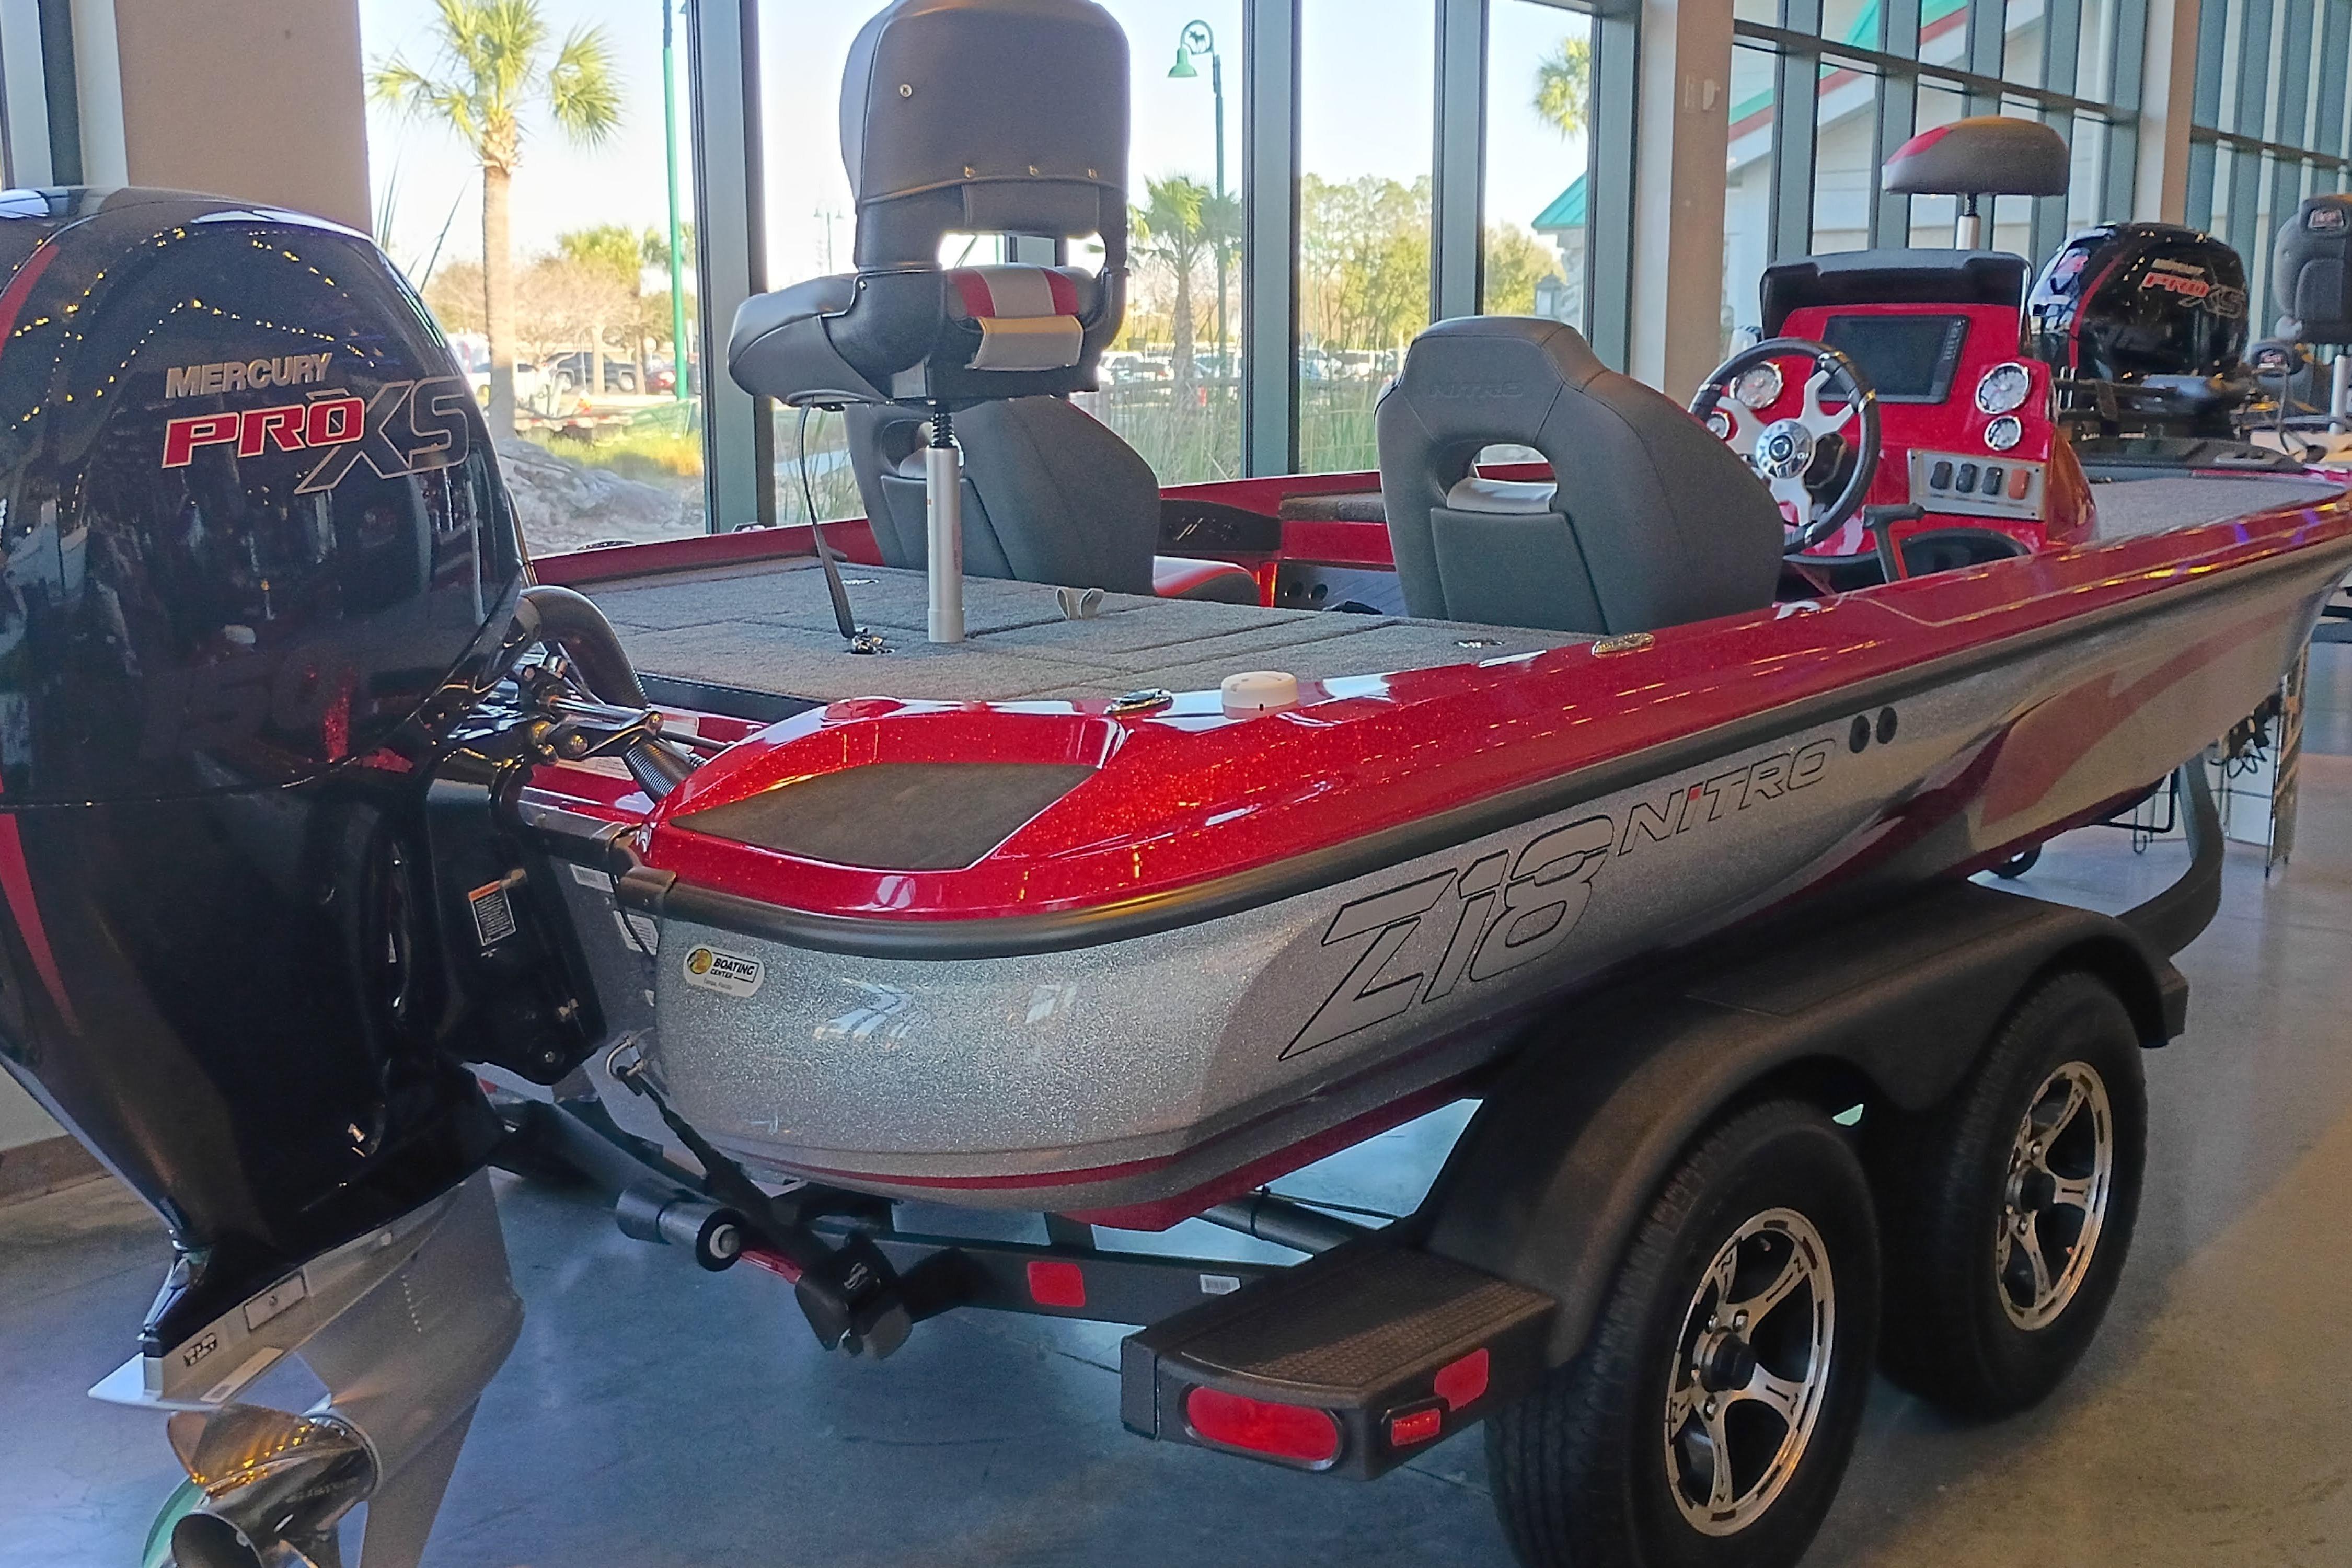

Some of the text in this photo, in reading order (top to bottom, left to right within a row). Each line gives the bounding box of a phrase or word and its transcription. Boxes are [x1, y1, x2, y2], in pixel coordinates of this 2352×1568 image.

[2141, 272, 2209, 298] PRO
[165, 352, 333, 399] MERCURY
[162, 376, 470, 494] PRO XS
[1617, 738, 1836, 856] NITRO
[1278, 815, 1616, 1061] Z18
[710, 969, 734, 979] CENTER
[713, 957, 755, 976] BOATING
